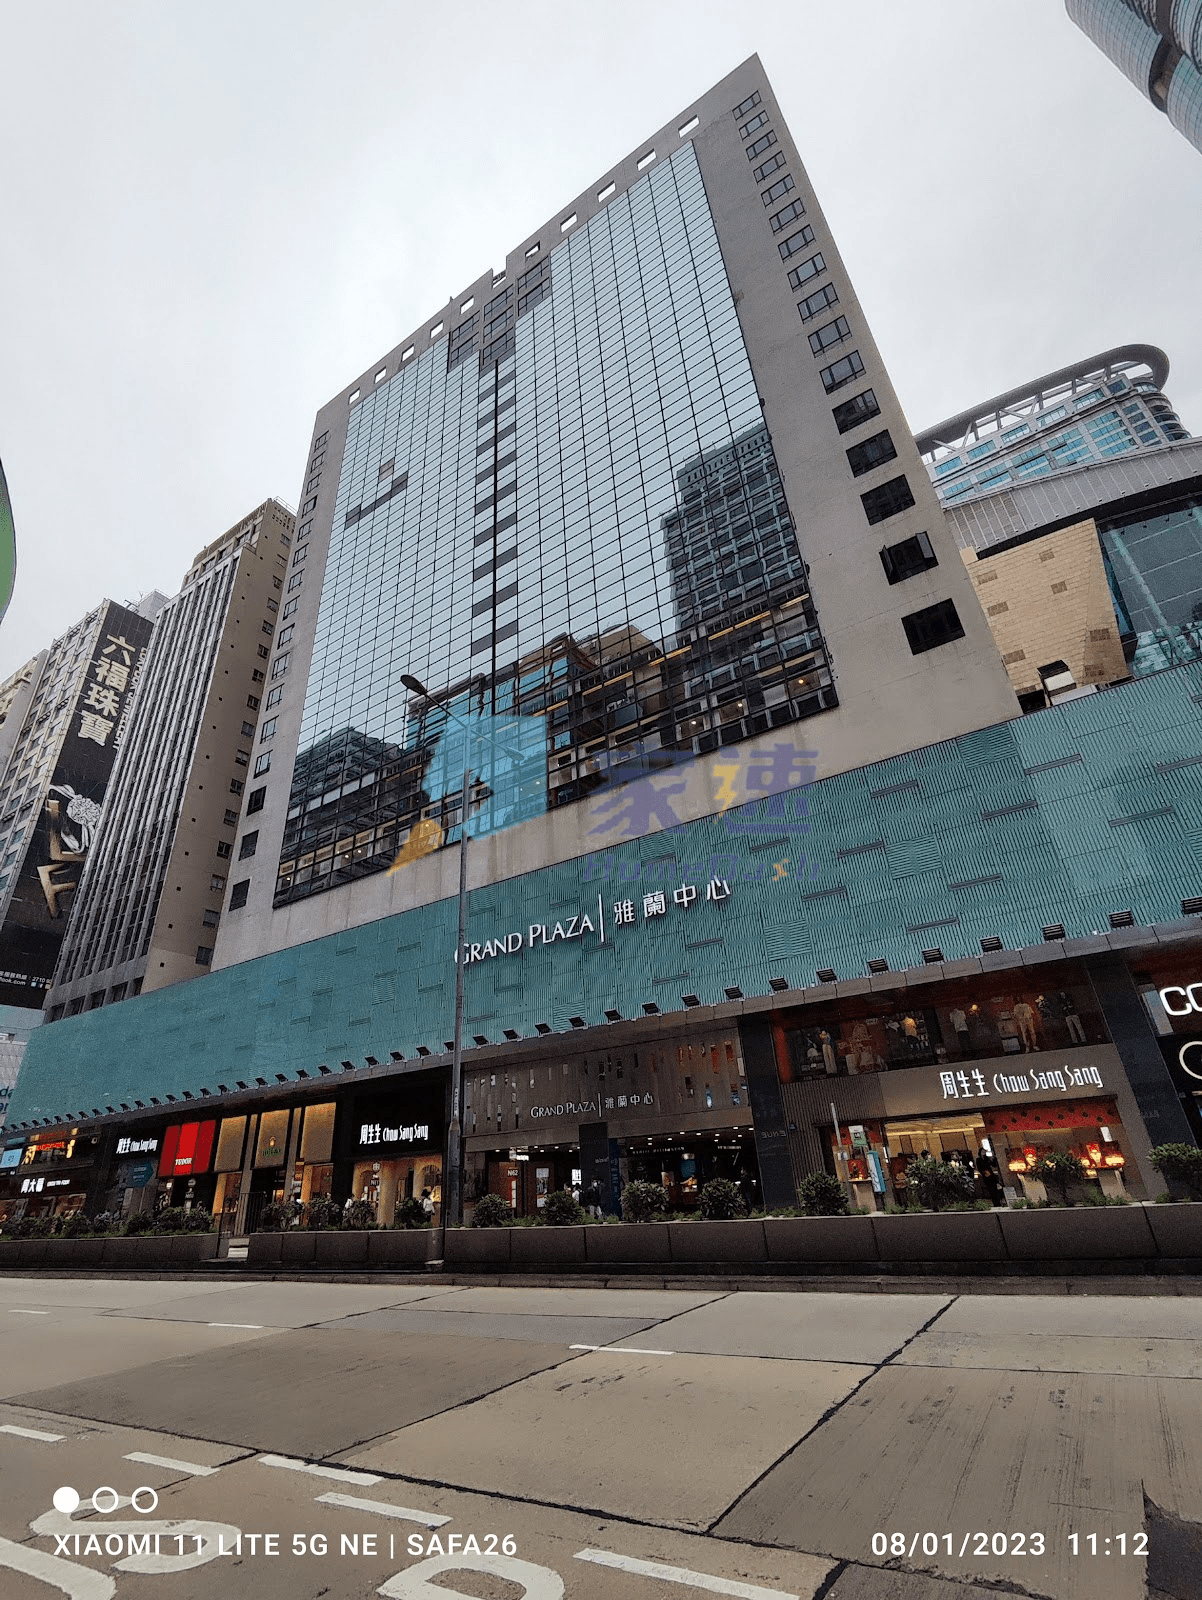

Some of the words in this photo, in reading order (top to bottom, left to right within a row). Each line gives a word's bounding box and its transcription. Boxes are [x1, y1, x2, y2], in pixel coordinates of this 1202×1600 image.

[78, 634, 136, 747] 六福珠寶
[454, 932, 523, 965] GRAND
[529, 914, 594, 948] PLAZA
[613, 875, 731, 925] 雅蘭中心
[940, 1068, 990, 1099] 周生生
[993, 1073, 1029, 1094] Chow
[1030, 1068, 1067, 1092] Sang
[1064, 1065, 1104, 1088] Sang
[530, 1104, 564, 1118] GRAND
[566, 1101, 596, 1114] PLAZA
[359, 1123, 381, 1145] 周生生
[383, 1127, 399, 1142] Chow
[399, 1124, 414, 1143] Sang
[414, 1123, 429, 1141] Sang
